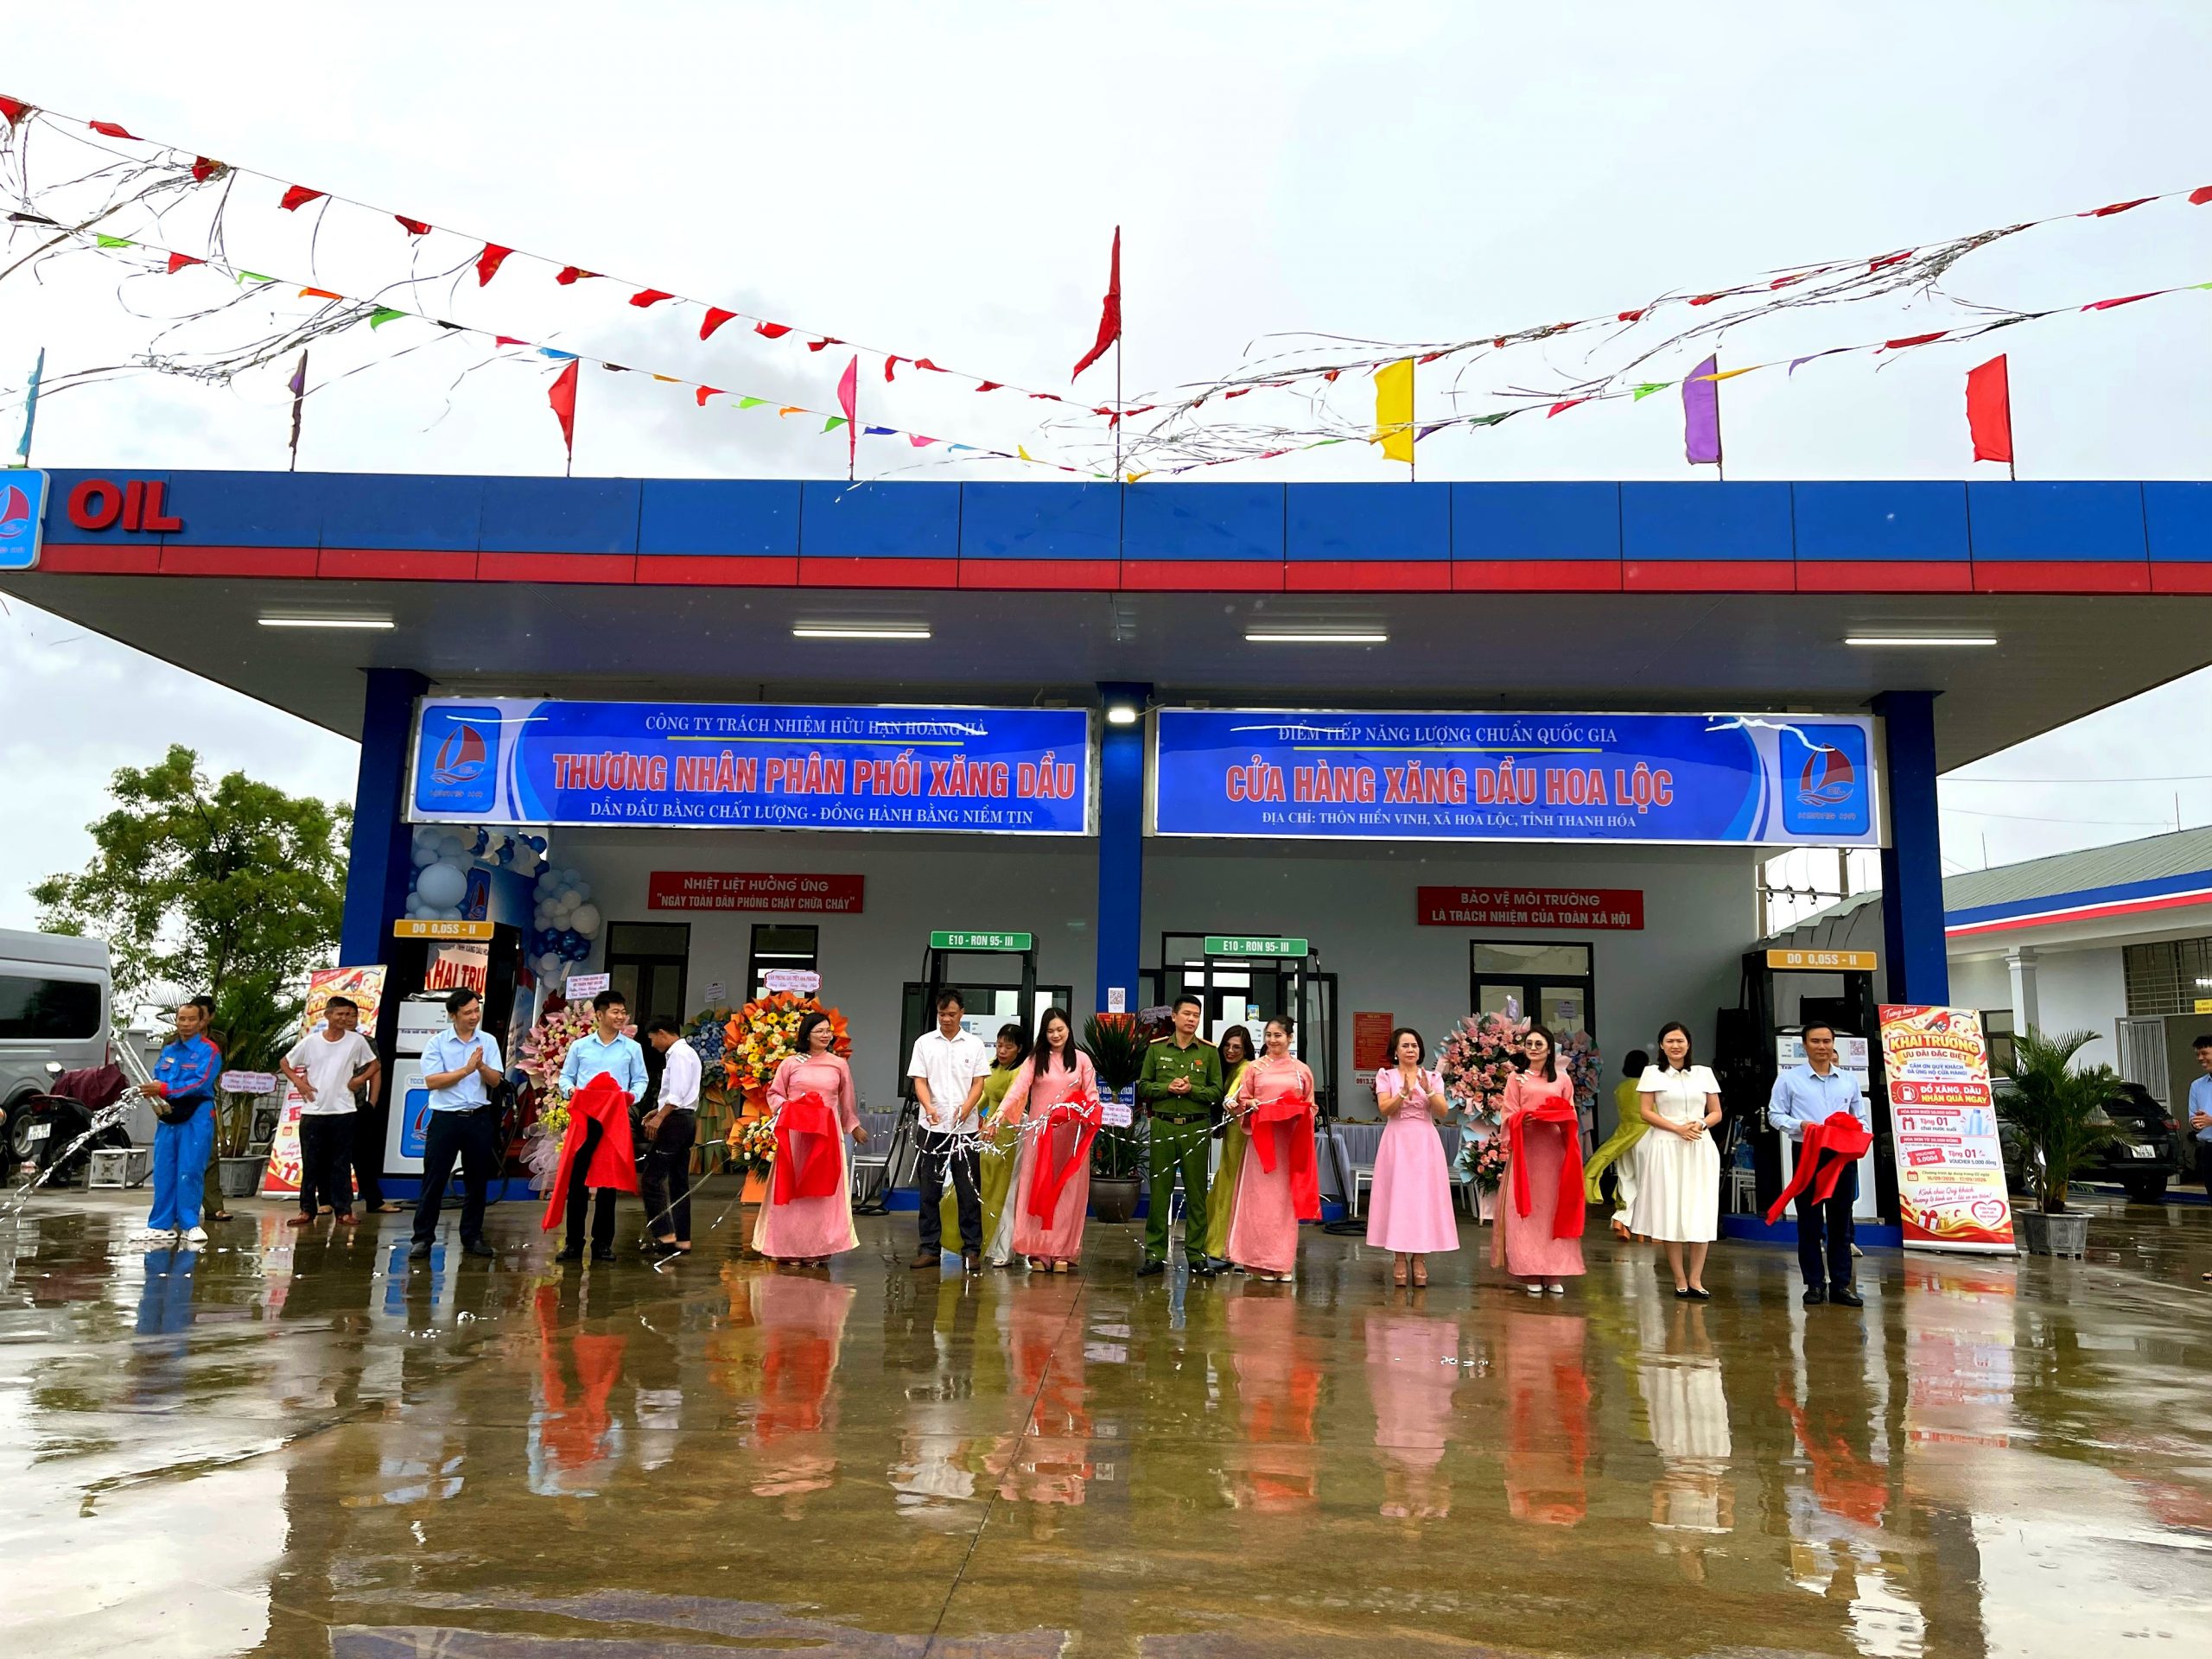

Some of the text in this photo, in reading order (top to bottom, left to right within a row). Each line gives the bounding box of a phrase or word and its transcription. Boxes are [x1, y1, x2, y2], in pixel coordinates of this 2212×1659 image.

[67, 479, 182, 532] OIL
[645, 713, 689, 731] CÔNG
[695, 717, 713, 731] TY
[717, 713, 768, 733] TRÁCH
[774, 715, 825, 735] NHIỆM
[830, 715, 863, 734] HỮU
[868, 721, 900, 738] HẠN
[906, 717, 961, 735] HOÀNG
[1279, 719, 1618, 746] ĐIỂM TIẾP NĂNG LƯỢNG CHUẨN QUỐC GIA
[553, 748, 1076, 798] THƯƠNG NHÂN PHÂN PHỐI XĂNG DẦU
[1226, 753, 1673, 814] CỬA HÀNG XĂNG DẦU HOA LỘC
[590, 796, 622, 816] DẪN
[626, 797, 659, 817] ĐẦU
[663, 797, 705, 817] BẰNG
[709, 798, 751, 819] CHẤT
[755, 804, 808, 821] LƯỢNG
[820, 801, 864, 821] ĐỒNG
[868, 804, 912, 822] HÀNH
[916, 802, 958, 823] BẰNG
[963, 804, 1002, 823] NIỀM
[1007, 810, 1033, 824] TIN
[1262, 812, 1285, 826] ĐỊA
[1288, 810, 1316, 824] CHỈ:
[1319, 810, 1357, 824] THÔN
[1395, 813, 1430, 827] VINH,
[1433, 810, 1452, 825] XÃ
[1455, 815, 1484, 826] HOA
[1486, 810, 1518, 829] LỘC,
[1557, 815, 1605, 827] THANH
[1608, 812, 1637, 828] HÓA
[683, 874, 829, 893] NHIỆT LIỆT HƯỞNG ỨNG
[657, 893, 685, 906] "NGÀY
[690, 894, 713, 907] TOÀN
[715, 895, 734, 907] DÂN
[737, 895, 768, 908] PHÒNG
[772, 896, 795, 909] CHÁY
[798, 896, 822, 909] CHỮA
[1460, 889, 1600, 907] BẢO VỆ MÔI TRƯỜNG
[1432, 908, 1630, 927] LÀ TRÁCH NHIỆM CỦA TOÀN XÃ HỘI
[431, 923, 459, 934] 0,05S
[949, 935, 963, 945] E10
[971, 935, 988, 946] RON
[1223, 940, 1238, 951] E10
[1246, 941, 1262, 951] RON
[1808, 953, 1838, 965] 0,05S
[1890, 1035, 1980, 1054] KHAI TRƯƠNG
[1950, 1052, 1967, 1061] BIỆT
[1963, 1084, 1981, 1095] DẦU
[1921, 1095, 1944, 1103] NHẬN
[1936, 1117, 1948, 1126] 01
[1965, 1149, 1977, 1158] 01
